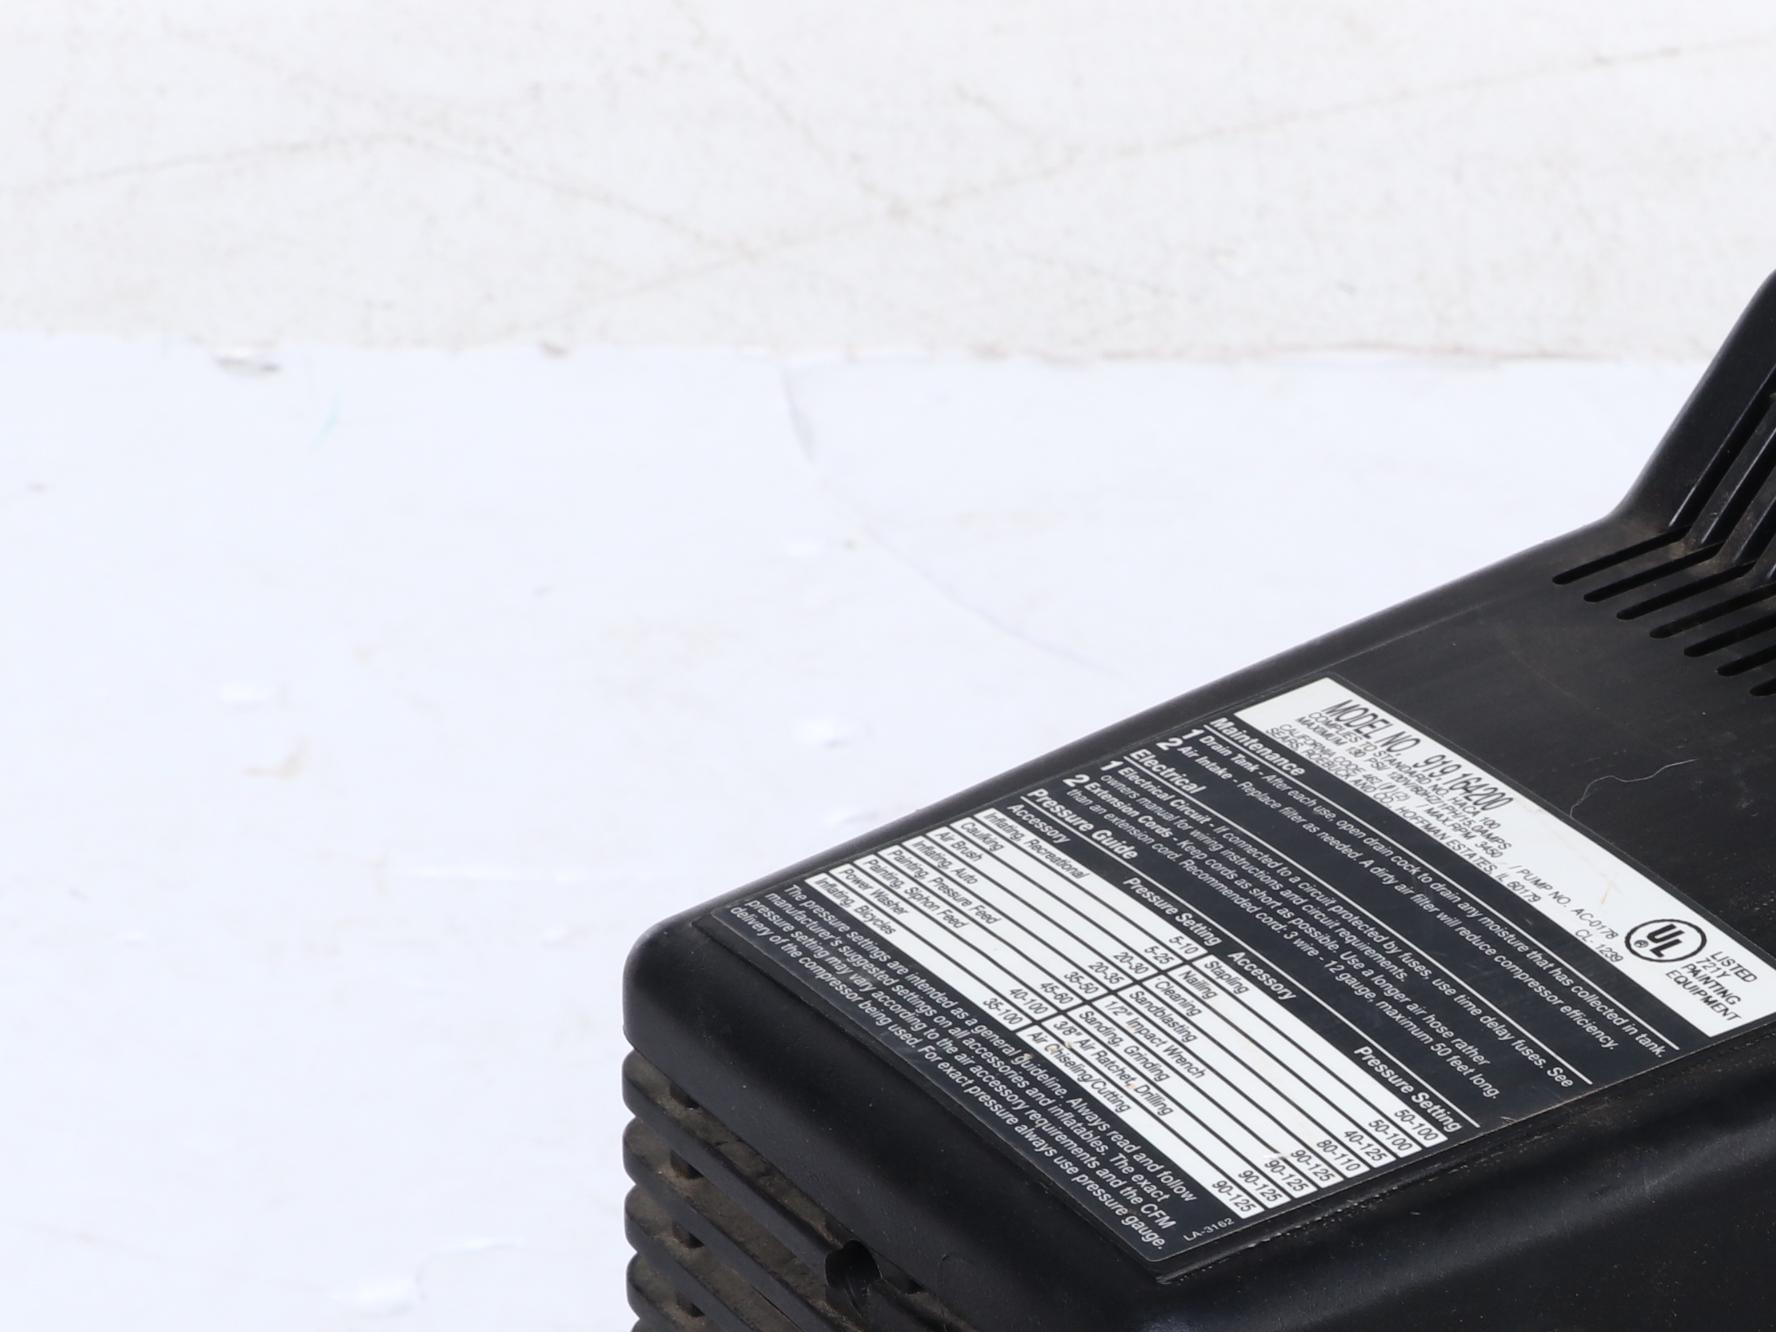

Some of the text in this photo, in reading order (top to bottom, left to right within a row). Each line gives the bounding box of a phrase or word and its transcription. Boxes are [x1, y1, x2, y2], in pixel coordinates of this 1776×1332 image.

[1209, 716, 1306, 777] Maintenance
[1321, 698, 1515, 812] MODEL NO. 919.164200
[1129, 748, 1208, 795] Electrical
[959, 821, 1006, 853] Caulking
[1006, 803, 1072, 844] Accessory
[1026, 787, 1139, 860] Pressure Guide
[911, 839, 979, 886] Inflating, Auto
[934, 831, 984, 863] Air Brush
[983, 811, 1091, 880] Inflating, Recreational
[837, 867, 910, 916] Power Washer
[862, 858, 970, 930] Painting, Siphon Feed
[887, 848, 1003, 925] Painting, Pressure Feed
[814, 876, 897, 936] Inflating, Bicycles
[1122, 876, 1223, 947] Pressure Setting
[1112, 950, 1150, 975] 20-30
[1143, 944, 1176, 965] 5-25
[1167, 934, 1200, 955] 5-10
[1062, 970, 1100, 995] 35-50
[1087, 960, 1126, 985] 20-35
[1177, 969, 1219, 1001] Nailing
[1203, 959, 1251, 996] Stapling
[1226, 951, 1297, 1001] Accessory
[1680, 962, 1742, 1006] PAINTING
[1695, 956, 1732, 980] 721Y
[1709, 950, 1758, 983] LISTED
[981, 997, 1024, 1026] 35-100
[1009, 987, 1050, 1015] 40-100
[1039, 981, 1075, 1005] 45-60
[1153, 980, 1203, 1018] Cleaning
[1664, 969, 1742, 1022] EQUIPMENT
[1128, 989, 1199, 1044] Sandblasting
[1077, 1009, 1171, 1083] Sanding, Grinding
[1125, 1016, 1169, 1048] Impact
[1161, 1043, 1207, 1080] Wrench
[1026, 1031, 1132, 1114] Air Chiseling/Cutting
[1073, 1038, 1097, 1052] Air
[1090, 1048, 1138, 1088] Ratchet,
[1132, 1083, 1175, 1117] Drilling
[1353, 1045, 1463, 1133] Pressure Setting
[1367, 1118, 1414, 1152] 50-100
[1393, 1108, 1440, 1142] 50-100
[1315, 1138, 1362, 1172] 80-110
[1343, 1130, 1389, 1162] 40-125
[1263, 1158, 1310, 1192] 90-125
[1289, 1148, 1337, 1183] 90-125
[1211, 1179, 1258, 1213] 90-125
[1237, 1169, 1284, 1203] 90-125
